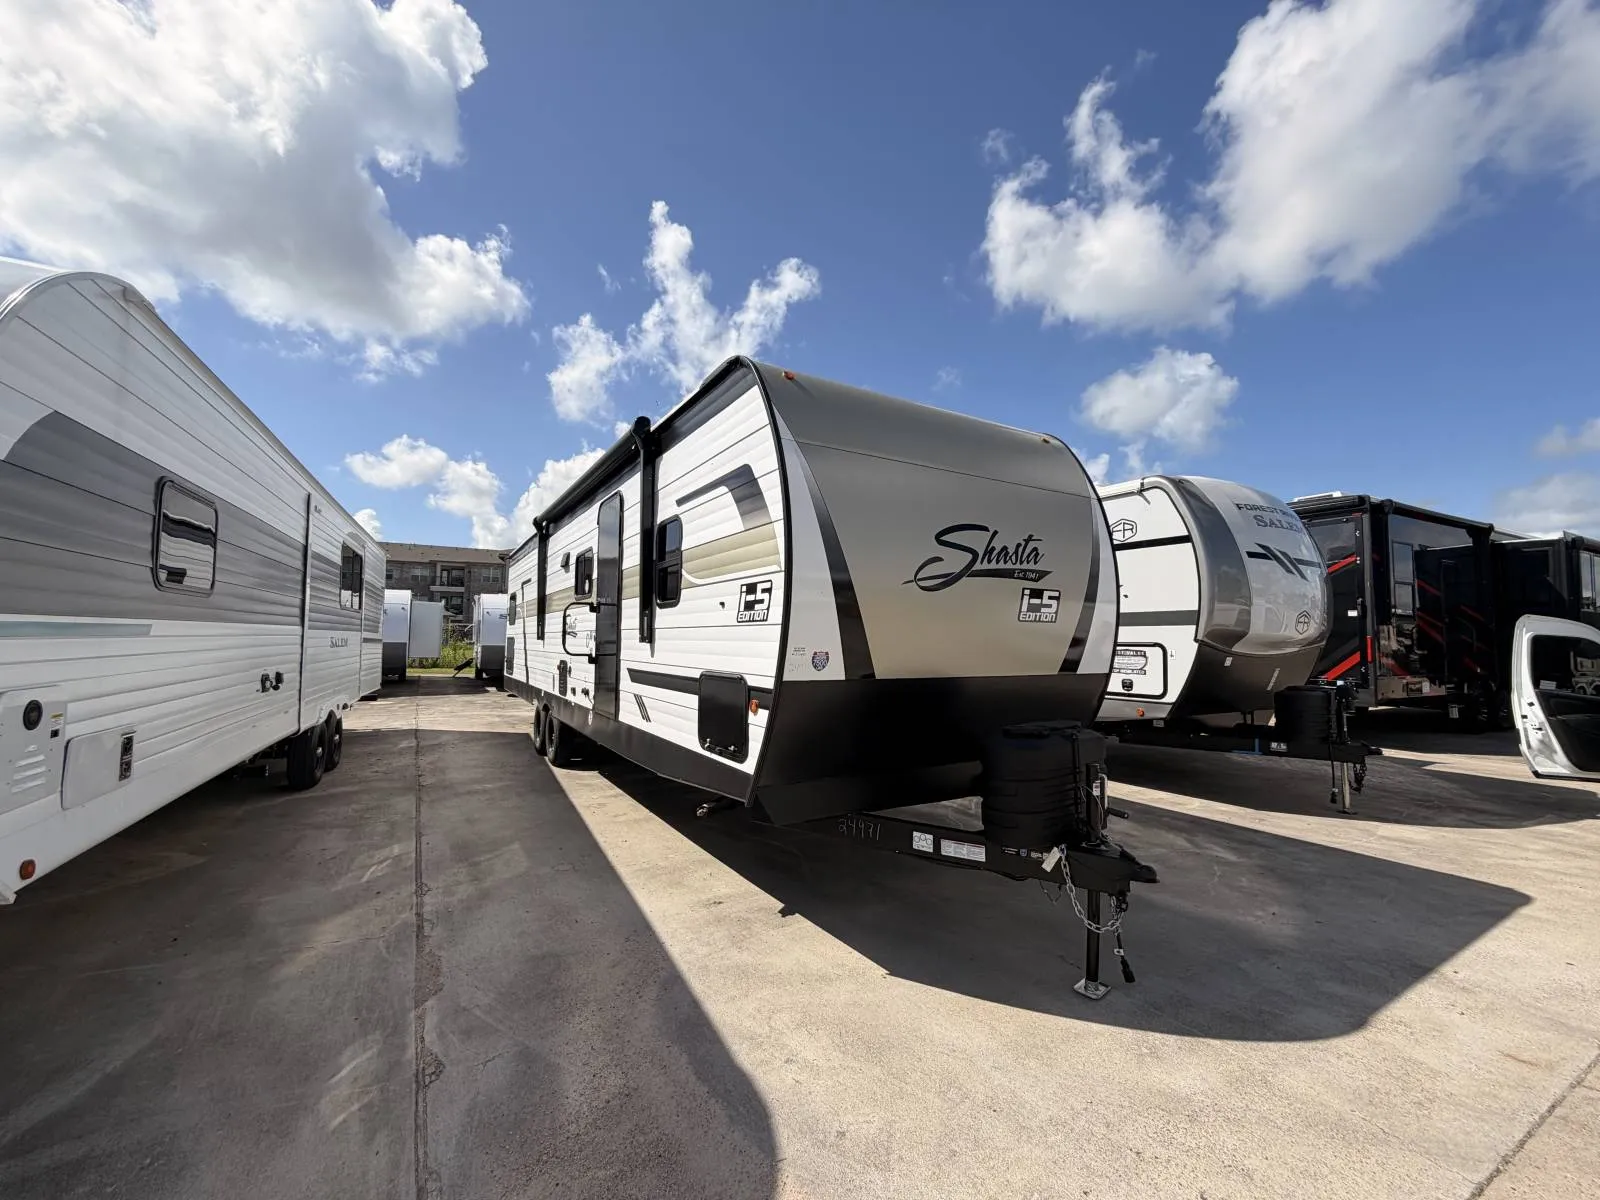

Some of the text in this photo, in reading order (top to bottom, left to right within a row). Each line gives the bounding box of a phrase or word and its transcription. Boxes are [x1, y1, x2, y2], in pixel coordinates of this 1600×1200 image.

[913, 523, 1044, 592] Shasta
[1021, 588, 1060, 613] i-5
[737, 610, 768, 622] EDITION
[1019, 611, 1056, 622] EDITION
